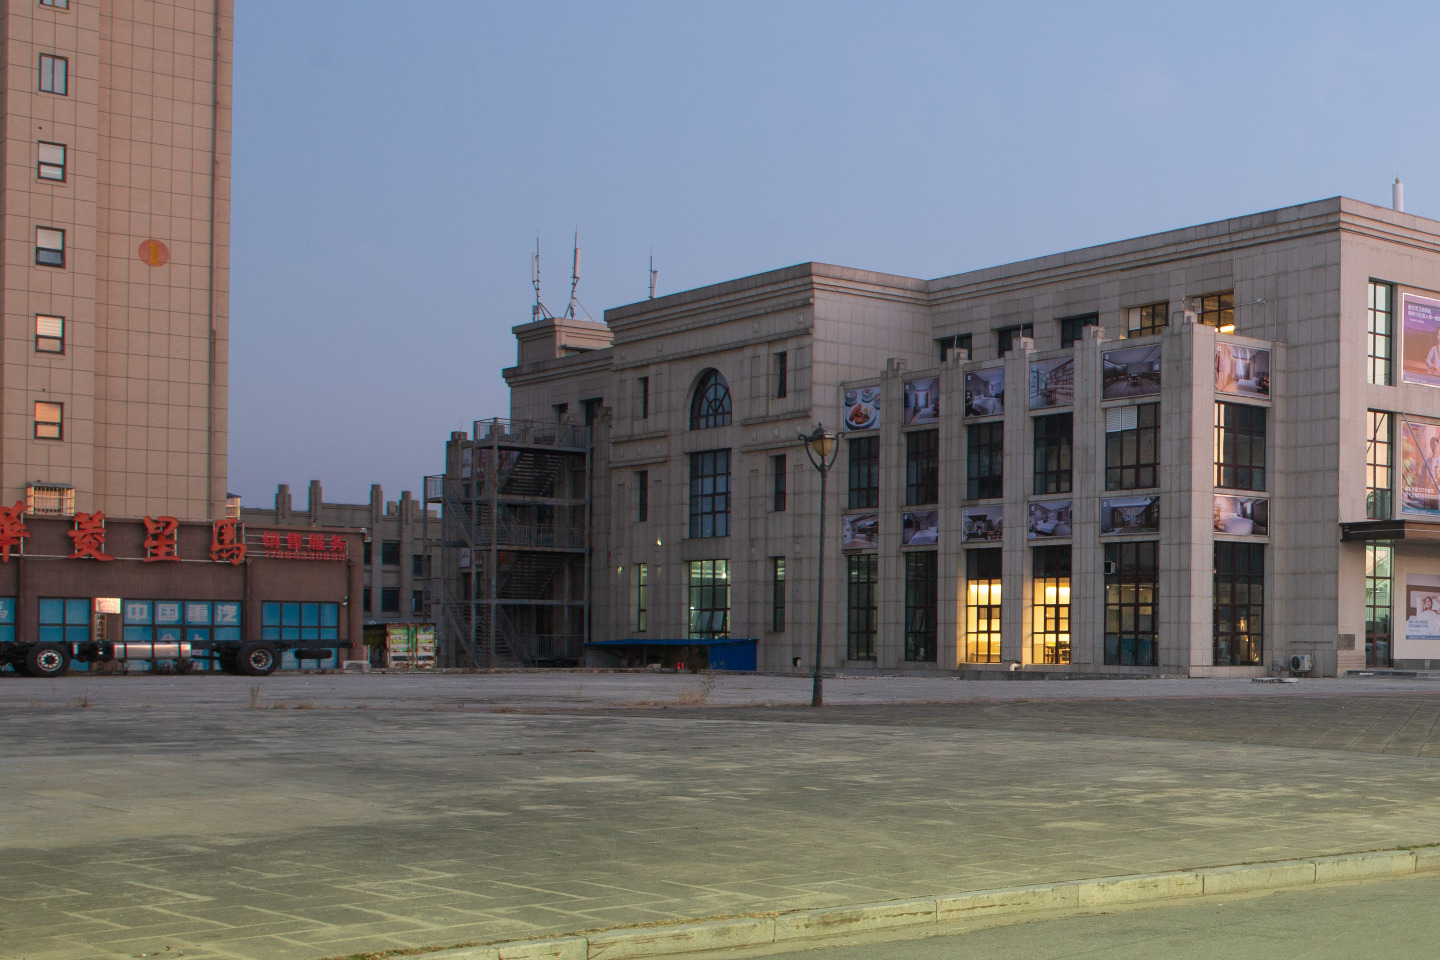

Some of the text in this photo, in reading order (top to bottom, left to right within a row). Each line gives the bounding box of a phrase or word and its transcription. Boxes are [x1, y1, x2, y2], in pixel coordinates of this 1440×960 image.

[149, 242, 161, 264] 1
[262, 531, 347, 551] 销售服务
[127, 603, 238, 623] 中国重汽
